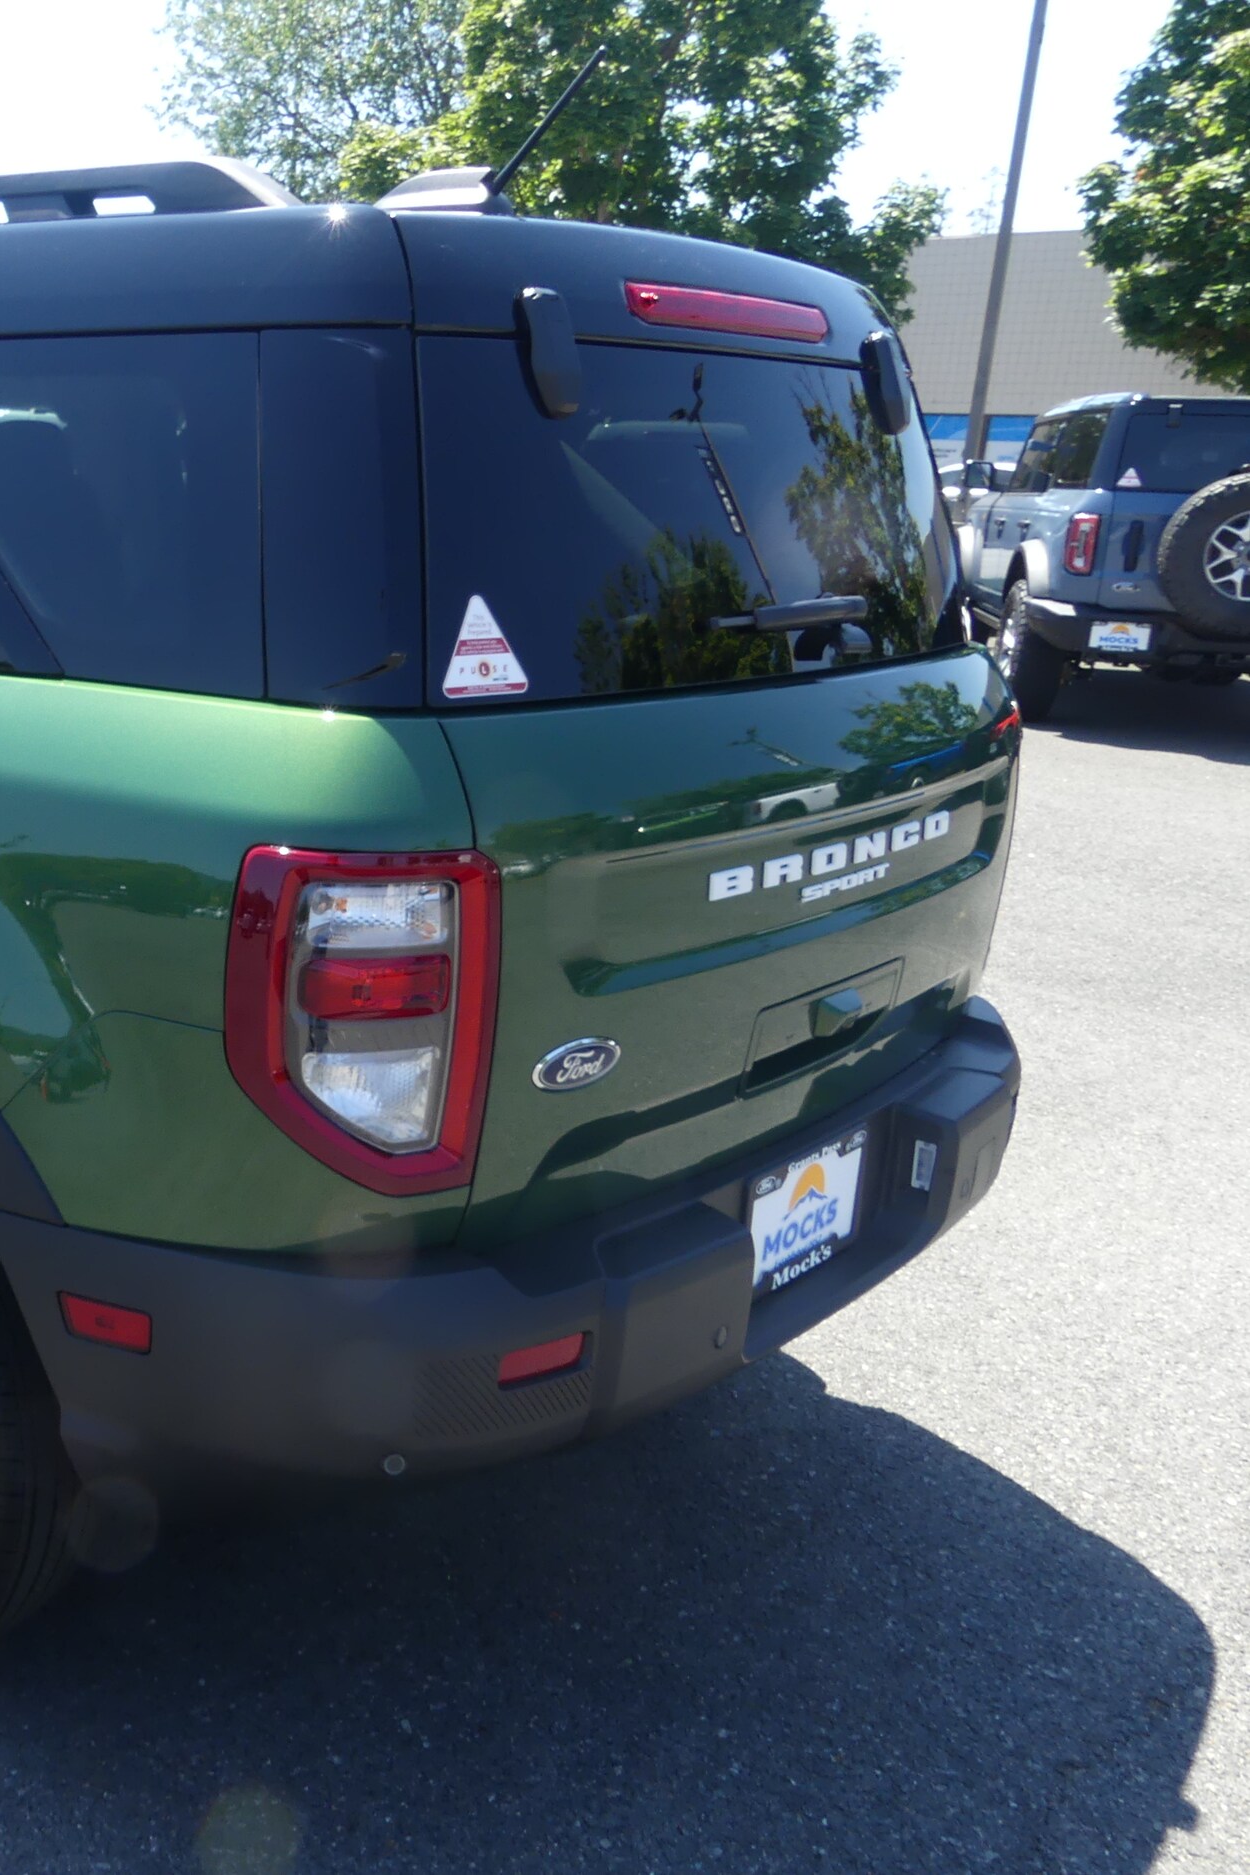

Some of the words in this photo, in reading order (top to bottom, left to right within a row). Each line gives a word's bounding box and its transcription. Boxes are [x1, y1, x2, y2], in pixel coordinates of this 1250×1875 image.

[708, 810, 950, 901] BRONCO
[801, 862, 890, 903] SPORT
[556, 1050, 605, 1082] Ford
[762, 1198, 839, 1262] MOCKS
[771, 1244, 832, 1291] Mock's
